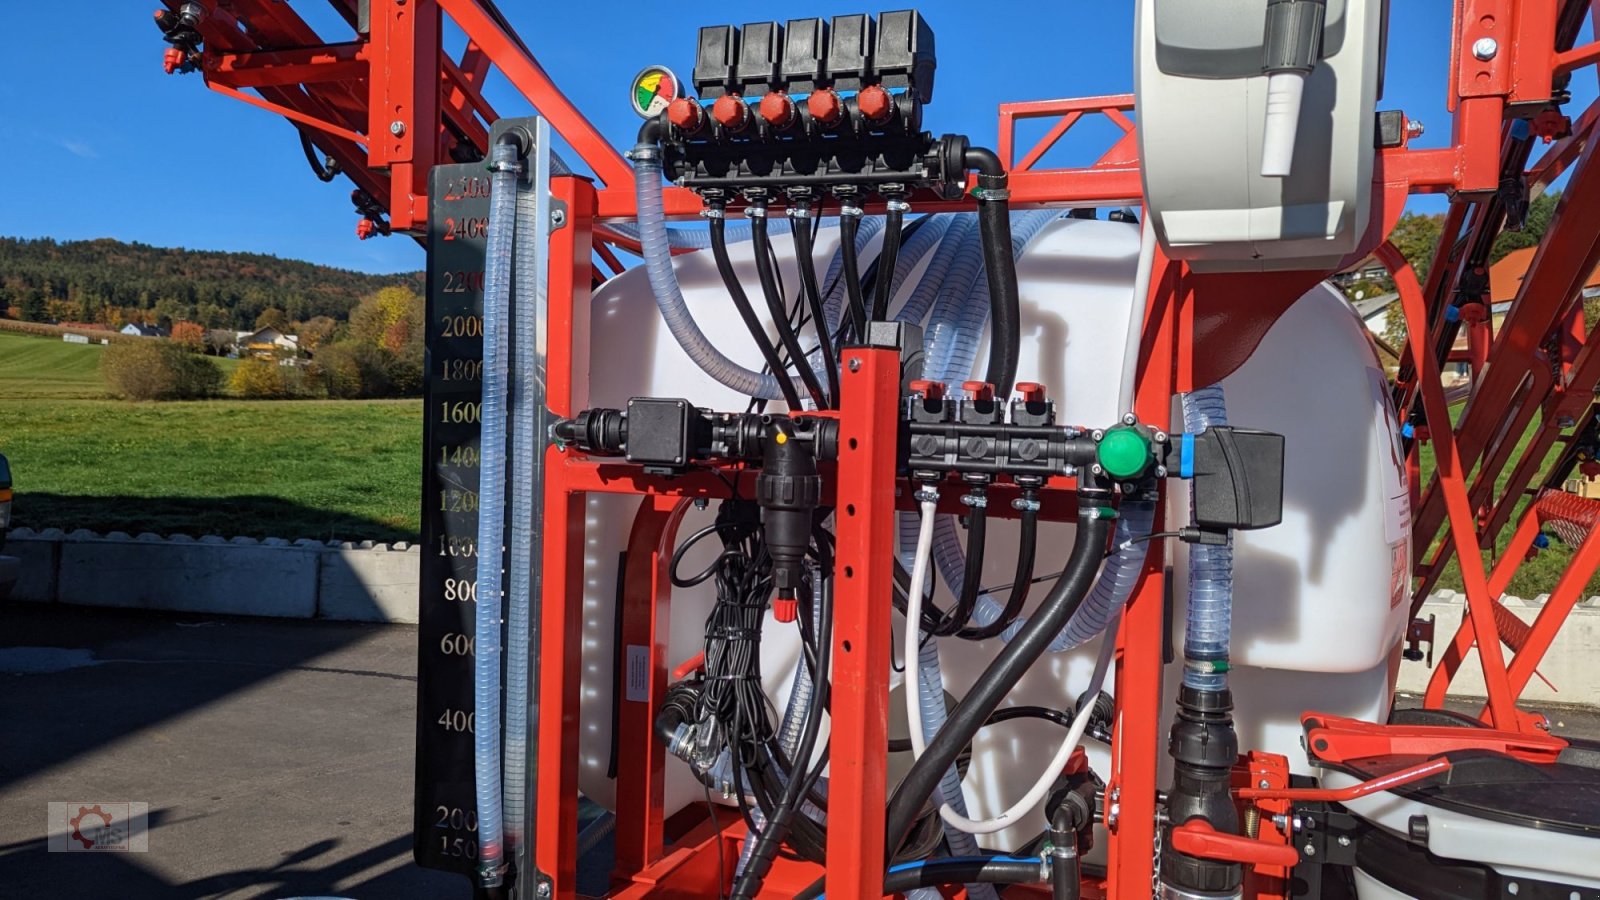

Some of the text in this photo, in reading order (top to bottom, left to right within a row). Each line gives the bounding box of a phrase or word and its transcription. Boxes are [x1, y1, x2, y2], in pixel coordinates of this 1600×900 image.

[443, 217, 490, 241] 2400
[435, 805, 478, 832] 200
[440, 836, 477, 859] 150
